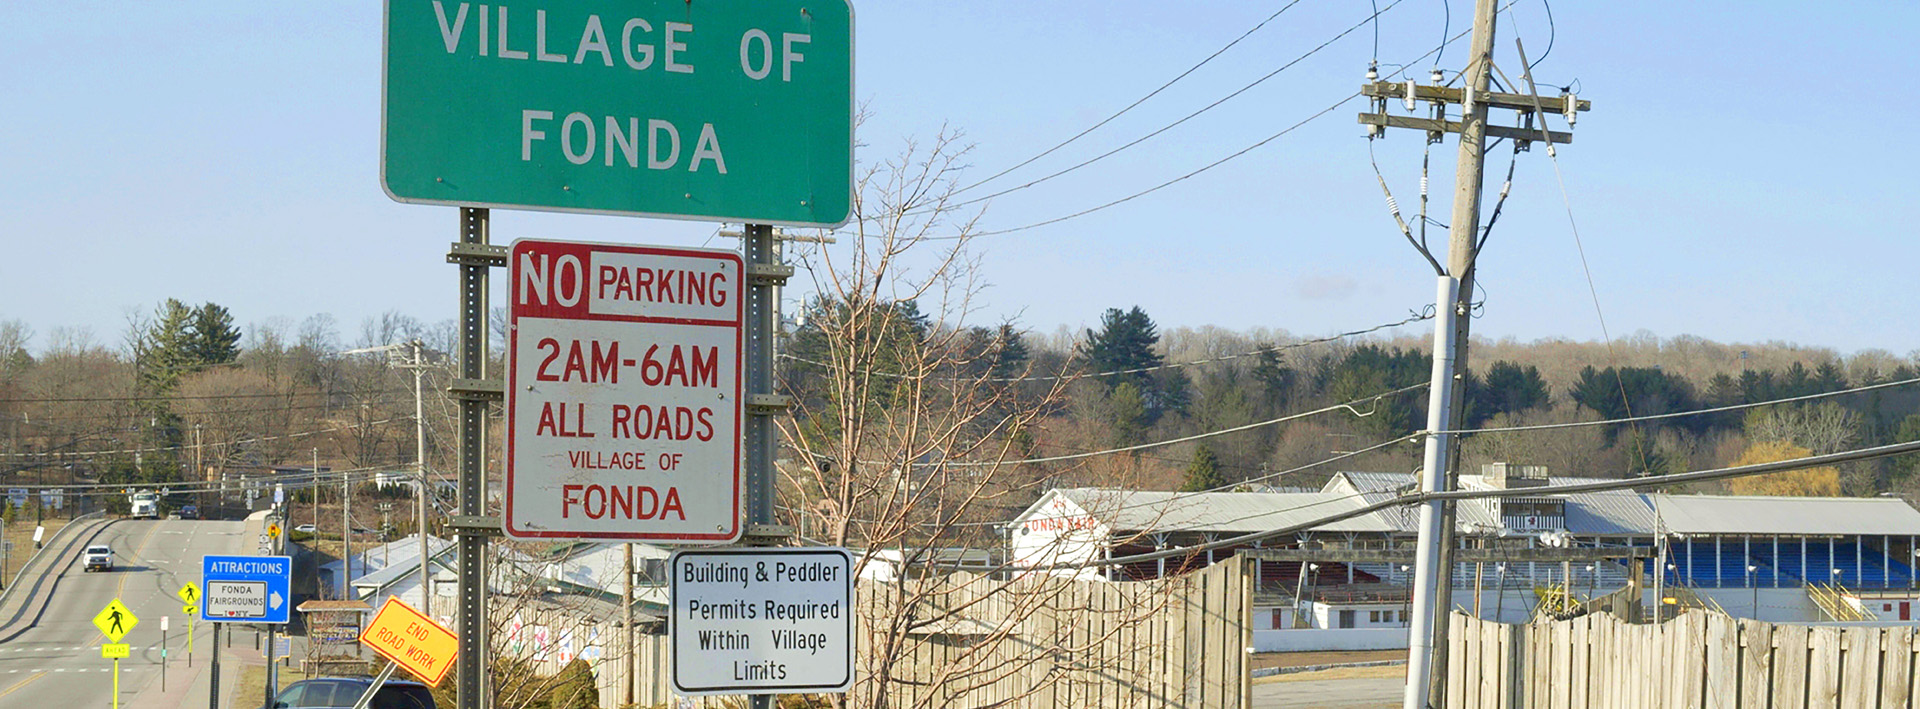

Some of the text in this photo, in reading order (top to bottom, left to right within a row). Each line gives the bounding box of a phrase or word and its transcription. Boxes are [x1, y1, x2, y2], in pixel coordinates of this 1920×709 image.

[432, 1, 811, 82] VILLAGE OF
[522, 109, 728, 174] FONDA
[519, 253, 727, 308] NO PARKING
[536, 338, 719, 388] 2AM-6AM
[536, 402, 714, 442] ALL ROADS
[568, 451, 683, 471] VILLAGE OF
[562, 484, 686, 521] FONDA
[211, 562, 283, 574] ATTRACTIONS
[684, 561, 839, 589] Building & Peddler
[210, 596, 264, 606] FAIRGROUNDS
[221, 585, 252, 594] FONDA
[689, 600, 839, 624] Permits Required
[406, 621, 430, 642] END
[699, 629, 827, 655] Within Village
[376, 626, 405, 650] ROAD
[406, 644, 437, 670] WORK
[734, 660, 787, 681] Limits
